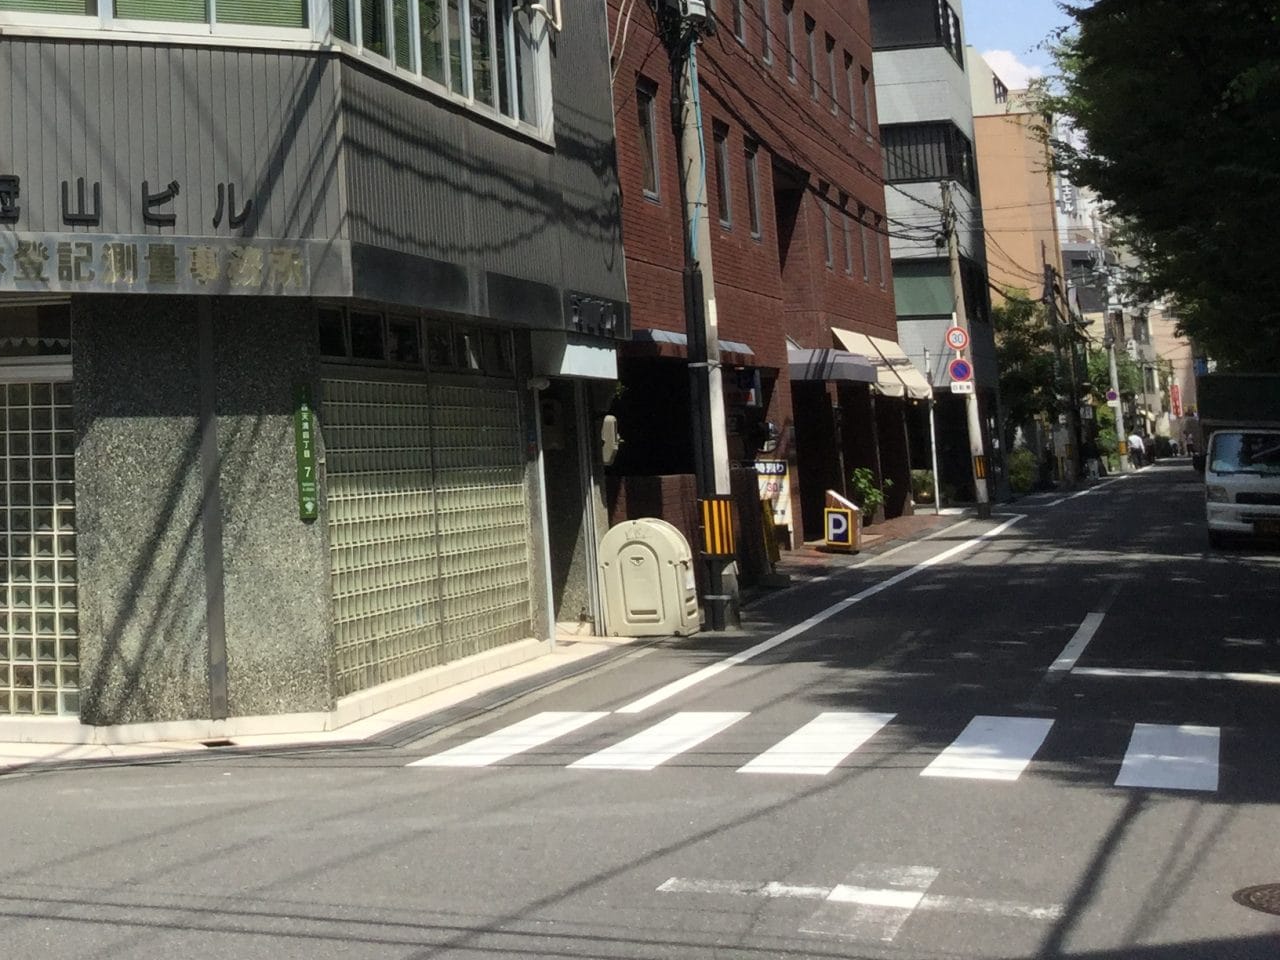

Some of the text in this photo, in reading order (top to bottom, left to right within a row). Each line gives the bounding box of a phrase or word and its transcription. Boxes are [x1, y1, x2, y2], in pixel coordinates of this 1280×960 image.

[951, 333, 963, 343] 30
[304, 467, 311, 477] 7
[828, 514, 848, 541] P
